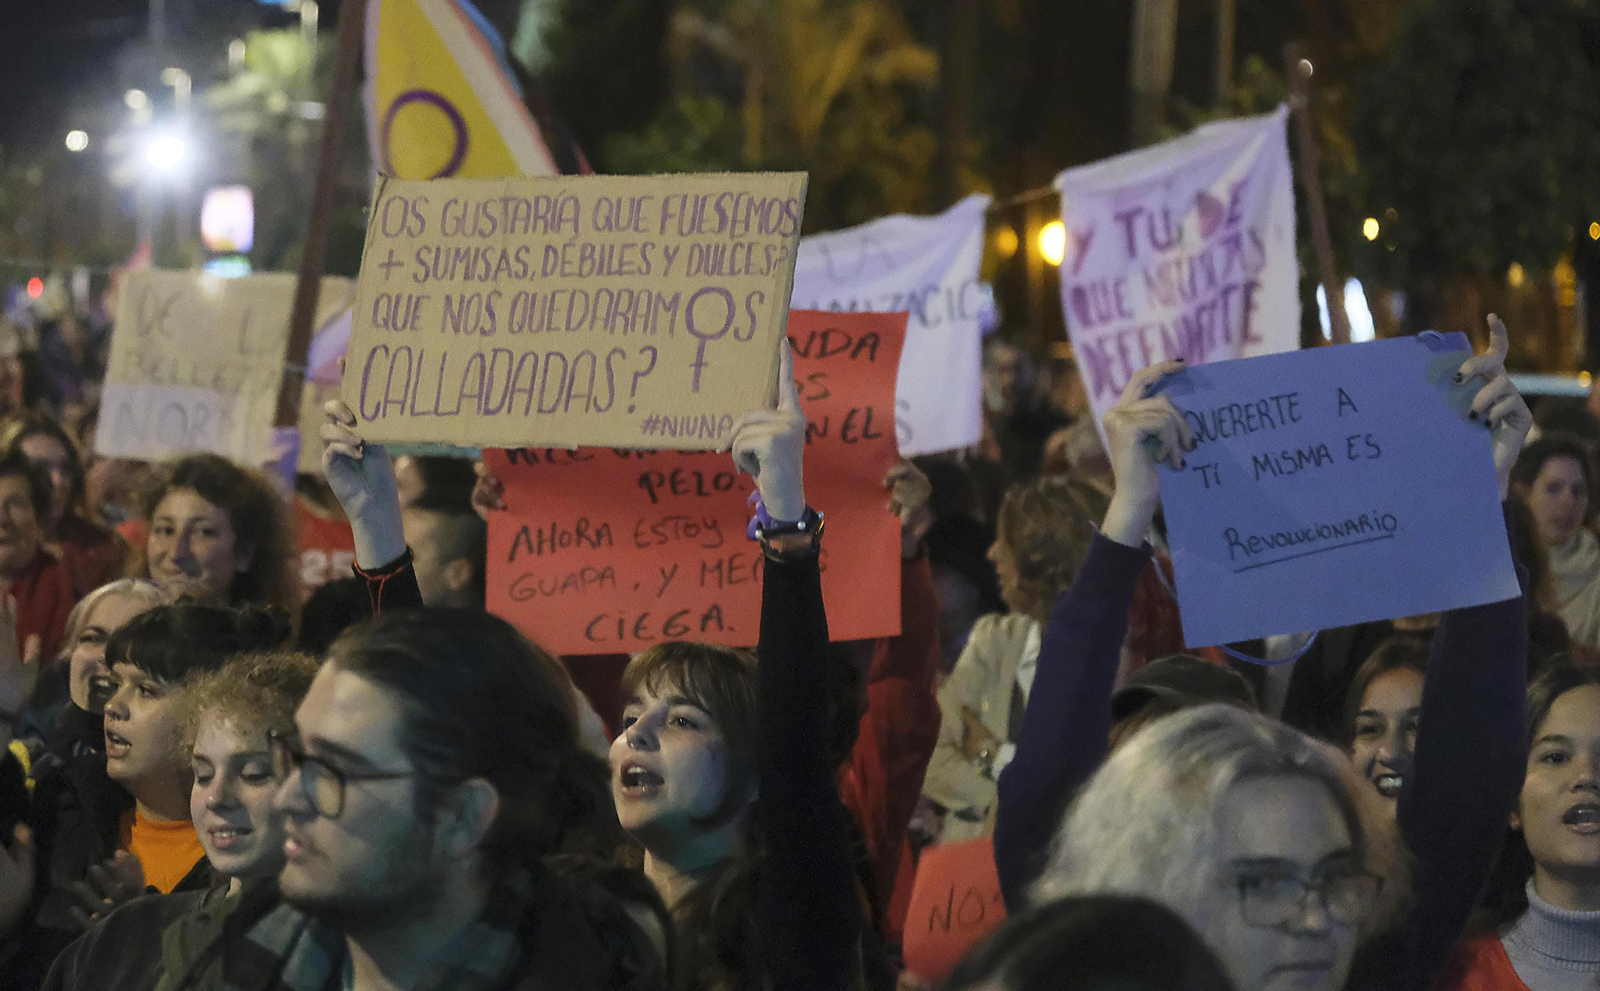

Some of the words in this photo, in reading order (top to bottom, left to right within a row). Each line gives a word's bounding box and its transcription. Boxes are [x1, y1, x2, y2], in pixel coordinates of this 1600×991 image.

[381, 195, 429, 238] OS
[440, 189, 580, 239] GUSTARÍA
[592, 195, 655, 233] QUE
[659, 191, 799, 240] FUESEMOS
[412, 245, 536, 283] SUMISAS,
[541, 234, 656, 278] DÉBILES
[663, 244, 681, 277] Y
[685, 240, 789, 278] DULCES?
[372, 293, 431, 331] QUE
[440, 289, 502, 337] NOS
[508, 286, 765, 345] QUEDARAMOS
[360, 343, 658, 422] CALLADADAS?
[841, 405, 883, 444] EL
[1184, 391, 1303, 444] QUERERTE
[1337, 386, 1358, 417] A
[1346, 433, 1382, 460] ES
[508, 517, 614, 563] AHORA
[633, 515, 725, 549] ESTOY
[657, 562, 679, 599] Y
[585, 604, 736, 642] CIEGA.
